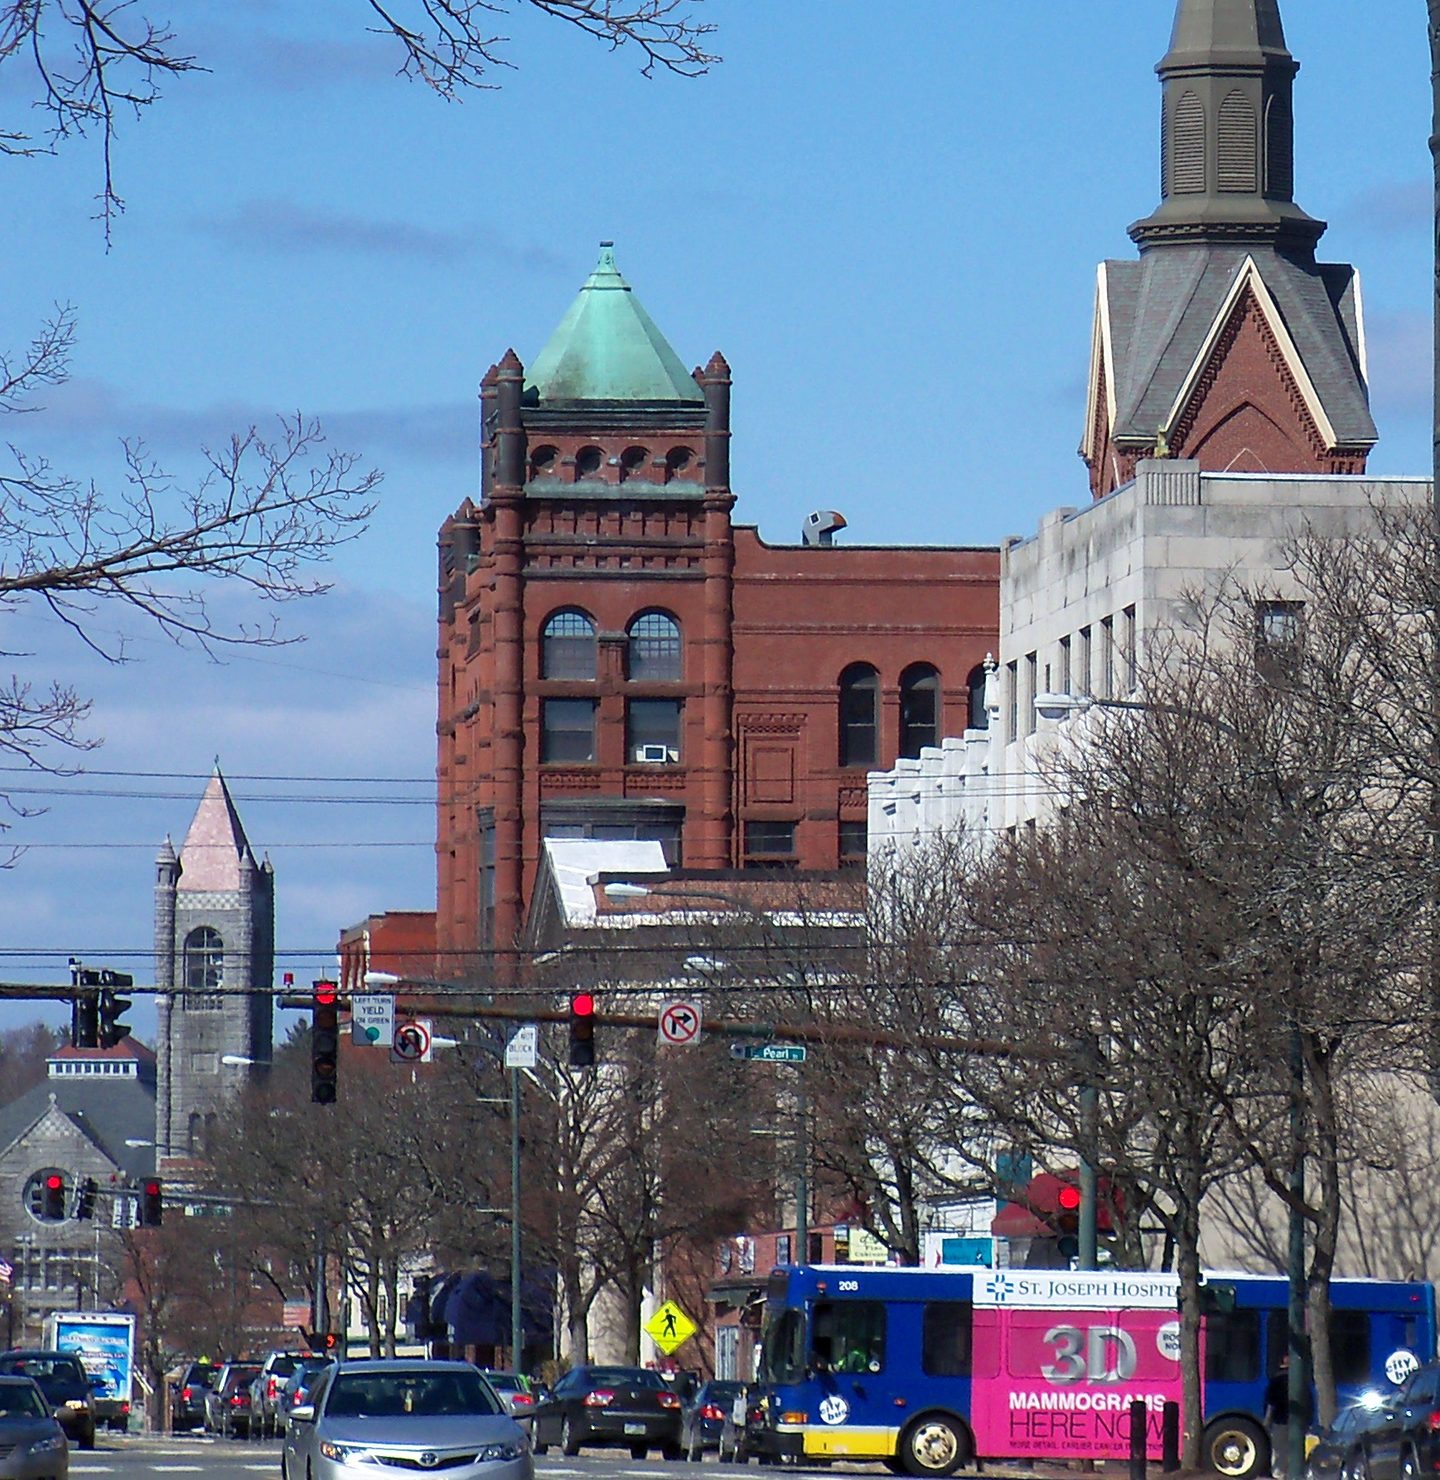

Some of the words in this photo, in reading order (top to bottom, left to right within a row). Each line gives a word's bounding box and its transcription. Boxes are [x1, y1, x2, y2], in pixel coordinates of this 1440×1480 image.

[362, 1006, 384, 1015] YIELD
[368, 1016, 390, 1024] GREEN
[763, 1047, 789, 1059] Pearl
[838, 1281, 859, 1291] 208
[1047, 1281, 1108, 1299] JOSEPH
[1040, 1325, 1137, 1387] 3D
[1009, 1391, 1167, 1412] MAMMOGRAMS
[1009, 1412, 1088, 1439] HERE
